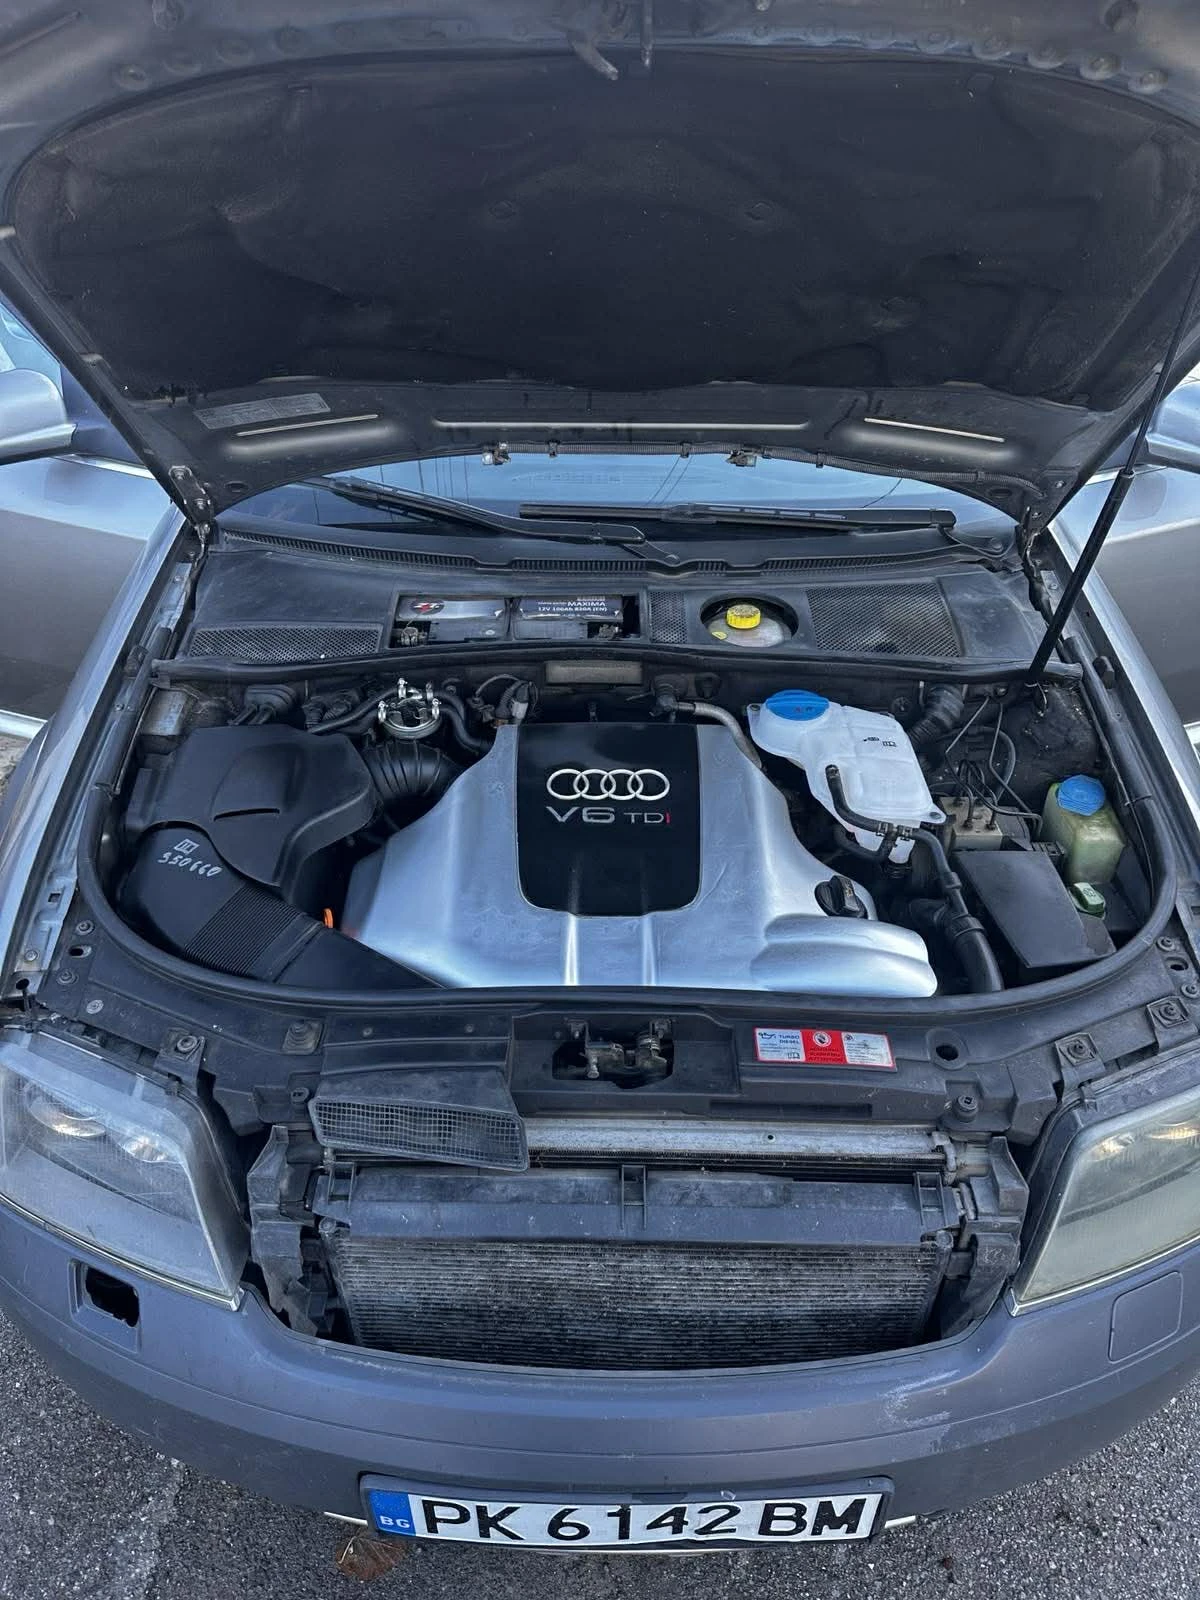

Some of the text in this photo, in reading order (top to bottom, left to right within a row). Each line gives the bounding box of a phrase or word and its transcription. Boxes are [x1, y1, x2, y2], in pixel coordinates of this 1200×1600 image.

[546, 806, 671, 824] V6 TDI
[379, 1497, 867, 1541] BG PK 6142 BM
